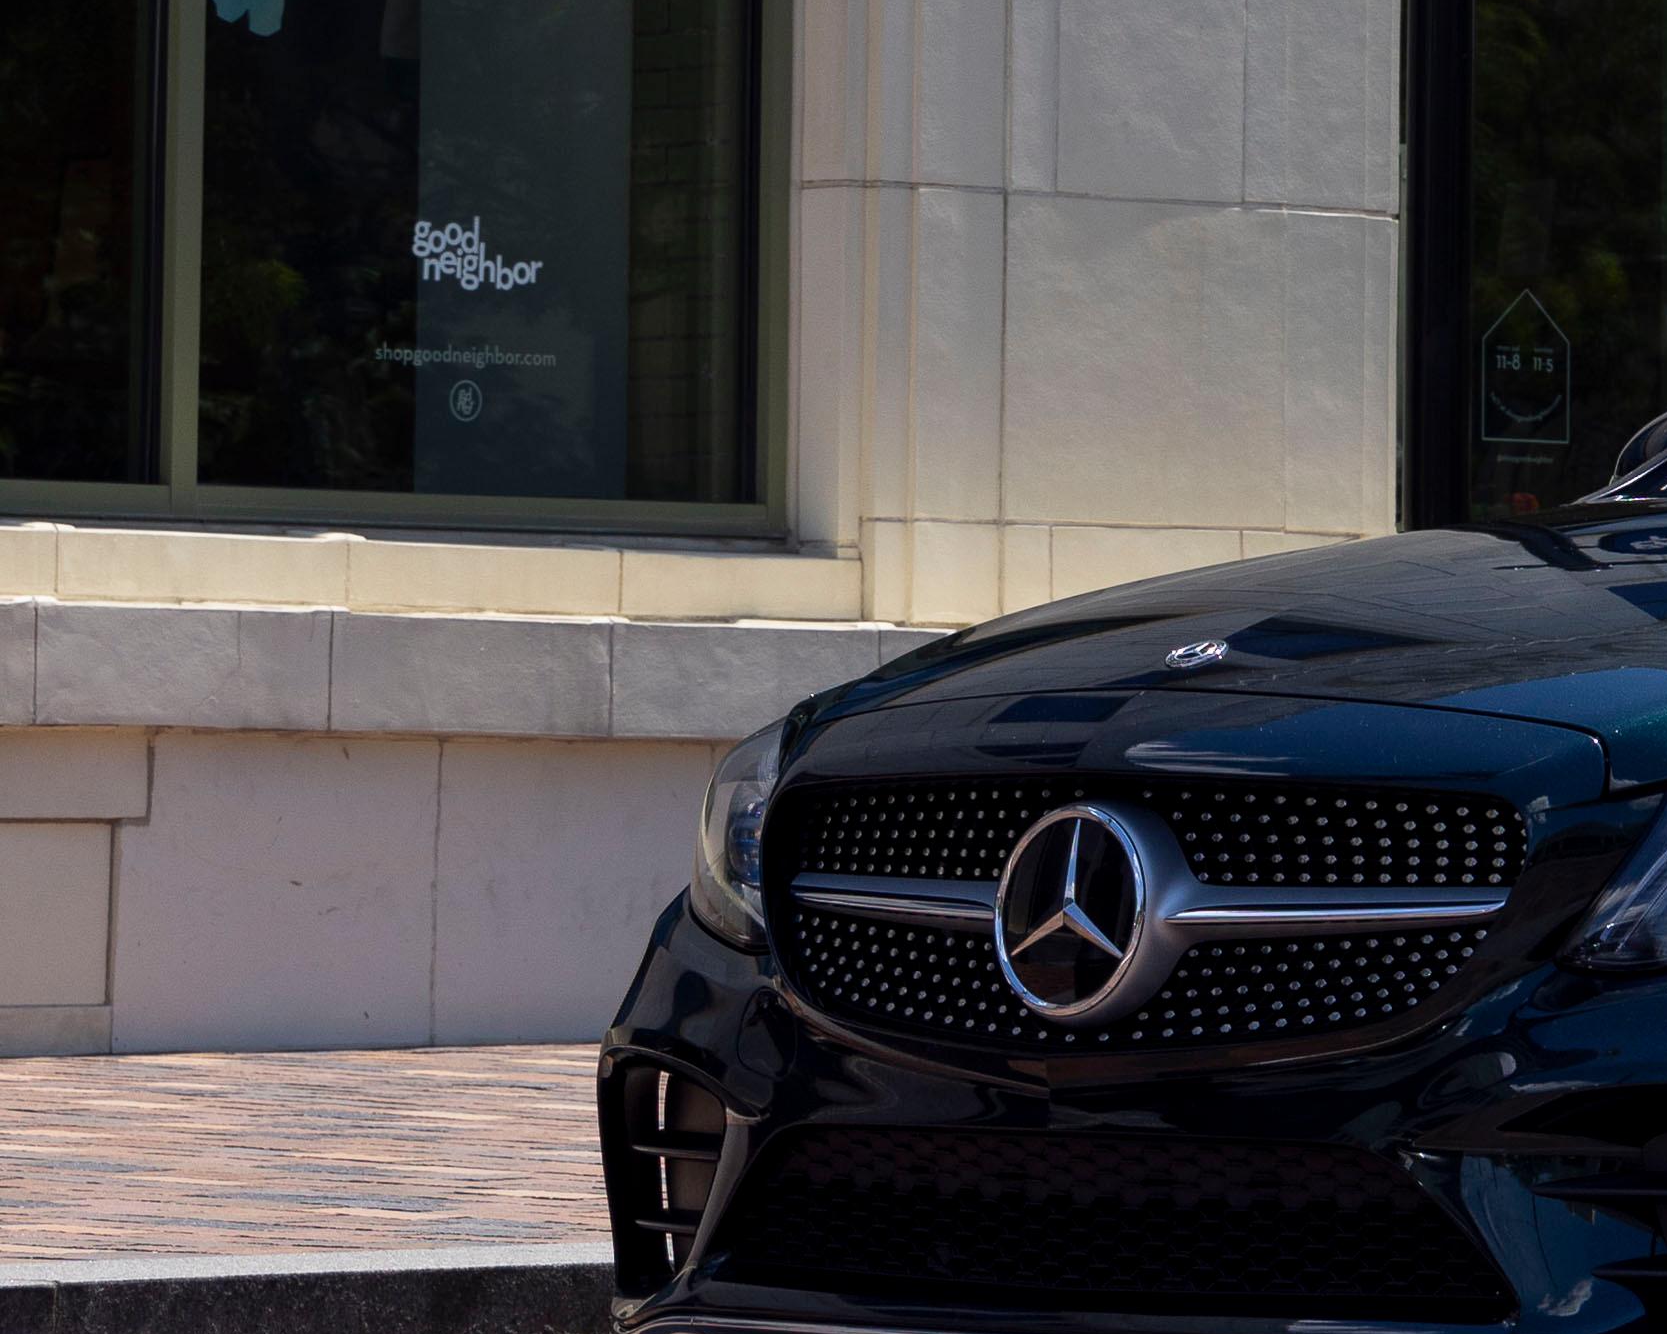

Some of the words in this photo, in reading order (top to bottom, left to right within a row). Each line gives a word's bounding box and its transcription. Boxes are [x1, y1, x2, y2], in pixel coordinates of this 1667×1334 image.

[411, 215, 481, 257] good
[422, 242, 544, 291] neighbor
[375, 341, 557, 369] shopgoodneighbor.com
[1496, 354, 1521, 371] 11-8
